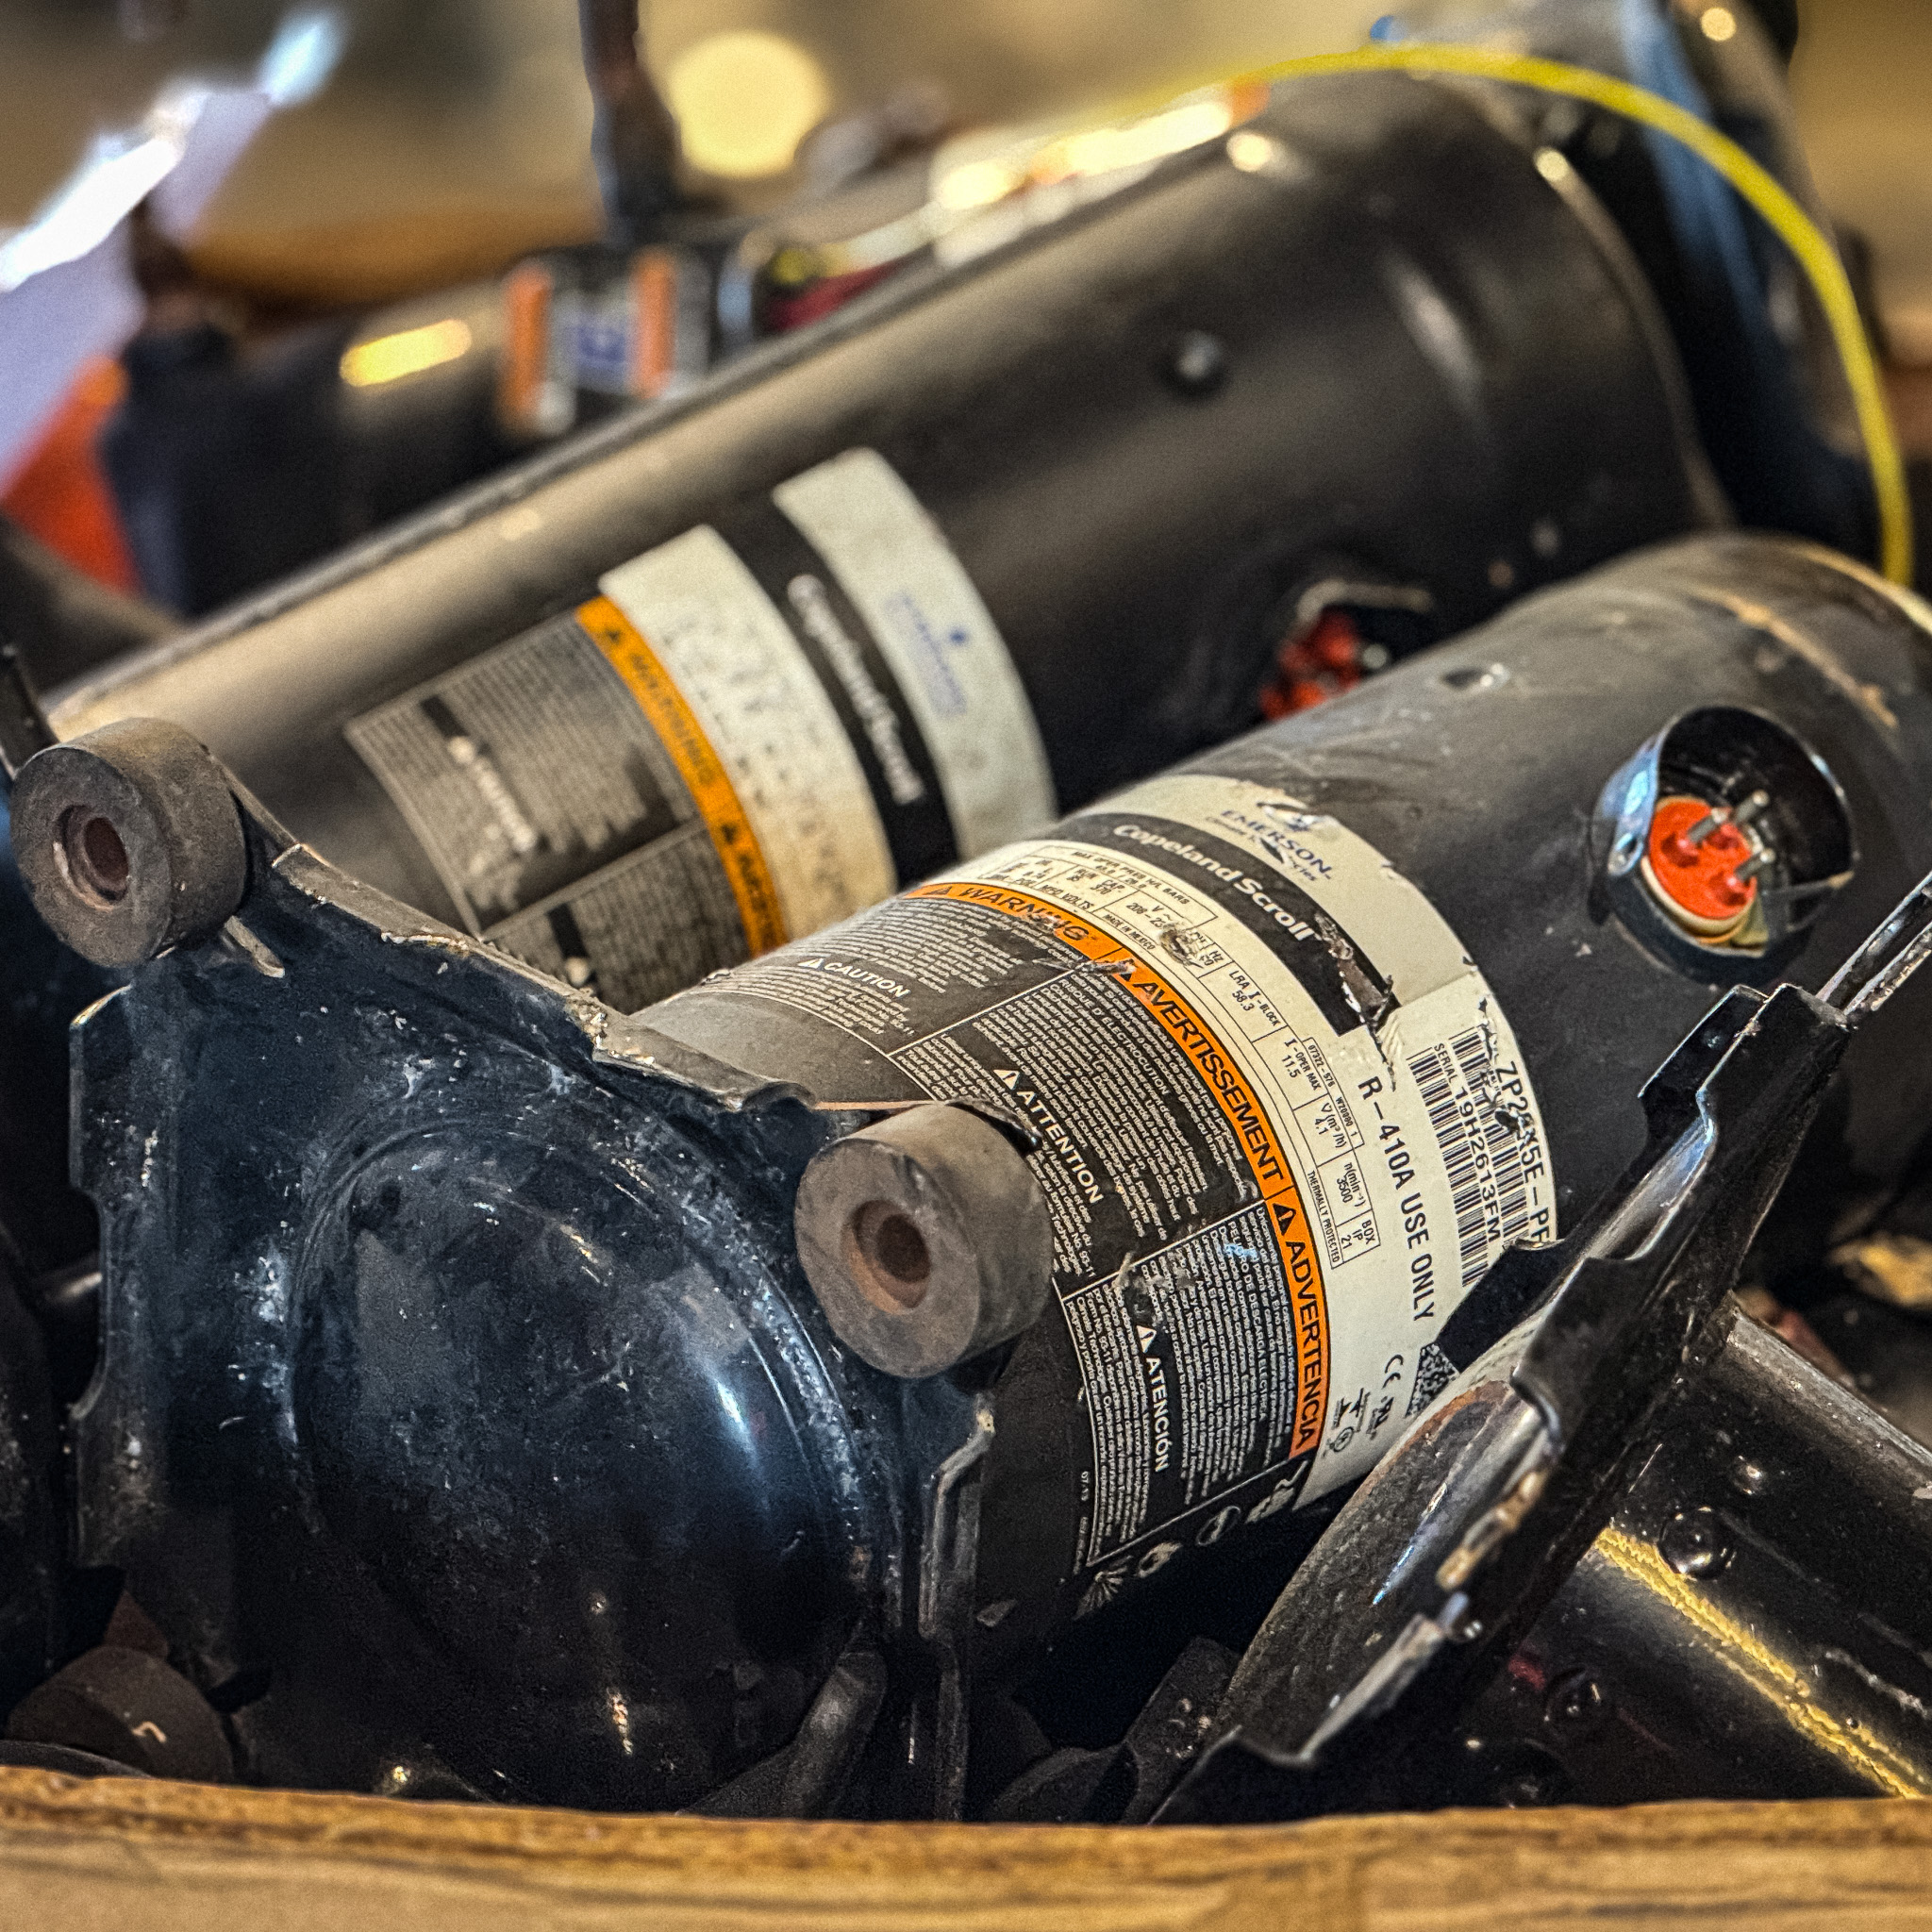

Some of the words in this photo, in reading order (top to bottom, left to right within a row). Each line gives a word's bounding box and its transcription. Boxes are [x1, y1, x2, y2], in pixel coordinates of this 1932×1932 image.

[1221, 808, 1331, 875] EMERSON
[1113, 824, 1243, 884] Copeland
[1233, 876, 1315, 941] Scroll
[1059, 893, 1093, 909] VOLTS
[1126, 903, 1169, 927] 208-23
[1126, 931, 1155, 949] MEXICO
[1209, 951, 1224, 962] Hz
[824, 962, 908, 996] CAUTION
[1058, 979, 1093, 1008] RISQUE
[1229, 971, 1249, 989] LRA
[1232, 991, 1254, 1010] 58.3
[1135, 983, 1282, 1178] AVERTISSEMENT
[1282, 1055, 1301, 1077] 11.5
[1307, 1073, 1321, 1090] MAX
[1315, 1119, 1328, 1134] 4.1
[1357, 1075, 1415, 1191] R-410A
[1433, 1042, 1458, 1084] SERIAL
[1455, 1085, 1501, 1242] 19H2613FM
[1018, 1091, 1102, 1202] ATTENTION
[1337, 1175, 1352, 1203] 3500
[1307, 1171, 1327, 1215] THERMALLY
[1324, 1219, 1340, 1262] PROTECTED
[1361, 1220, 1374, 1244] BOX
[1401, 1193, 1428, 1248] USE
[1341, 1235, 1352, 1249] 21
[1352, 1229, 1363, 1240] IP
[1411, 1254, 1434, 1320] ONLY
[1086, 1291, 1097, 1317] Form
[1099, 1336, 1111, 1362] 93-11
[1244, 1274, 1254, 1291] DE
[1249, 1293, 1264, 1357] DESCARGA
[1287, 1242, 1321, 1448] ADVERTENCIA
[1147, 1358, 1171, 1471] ATENCIÓN
